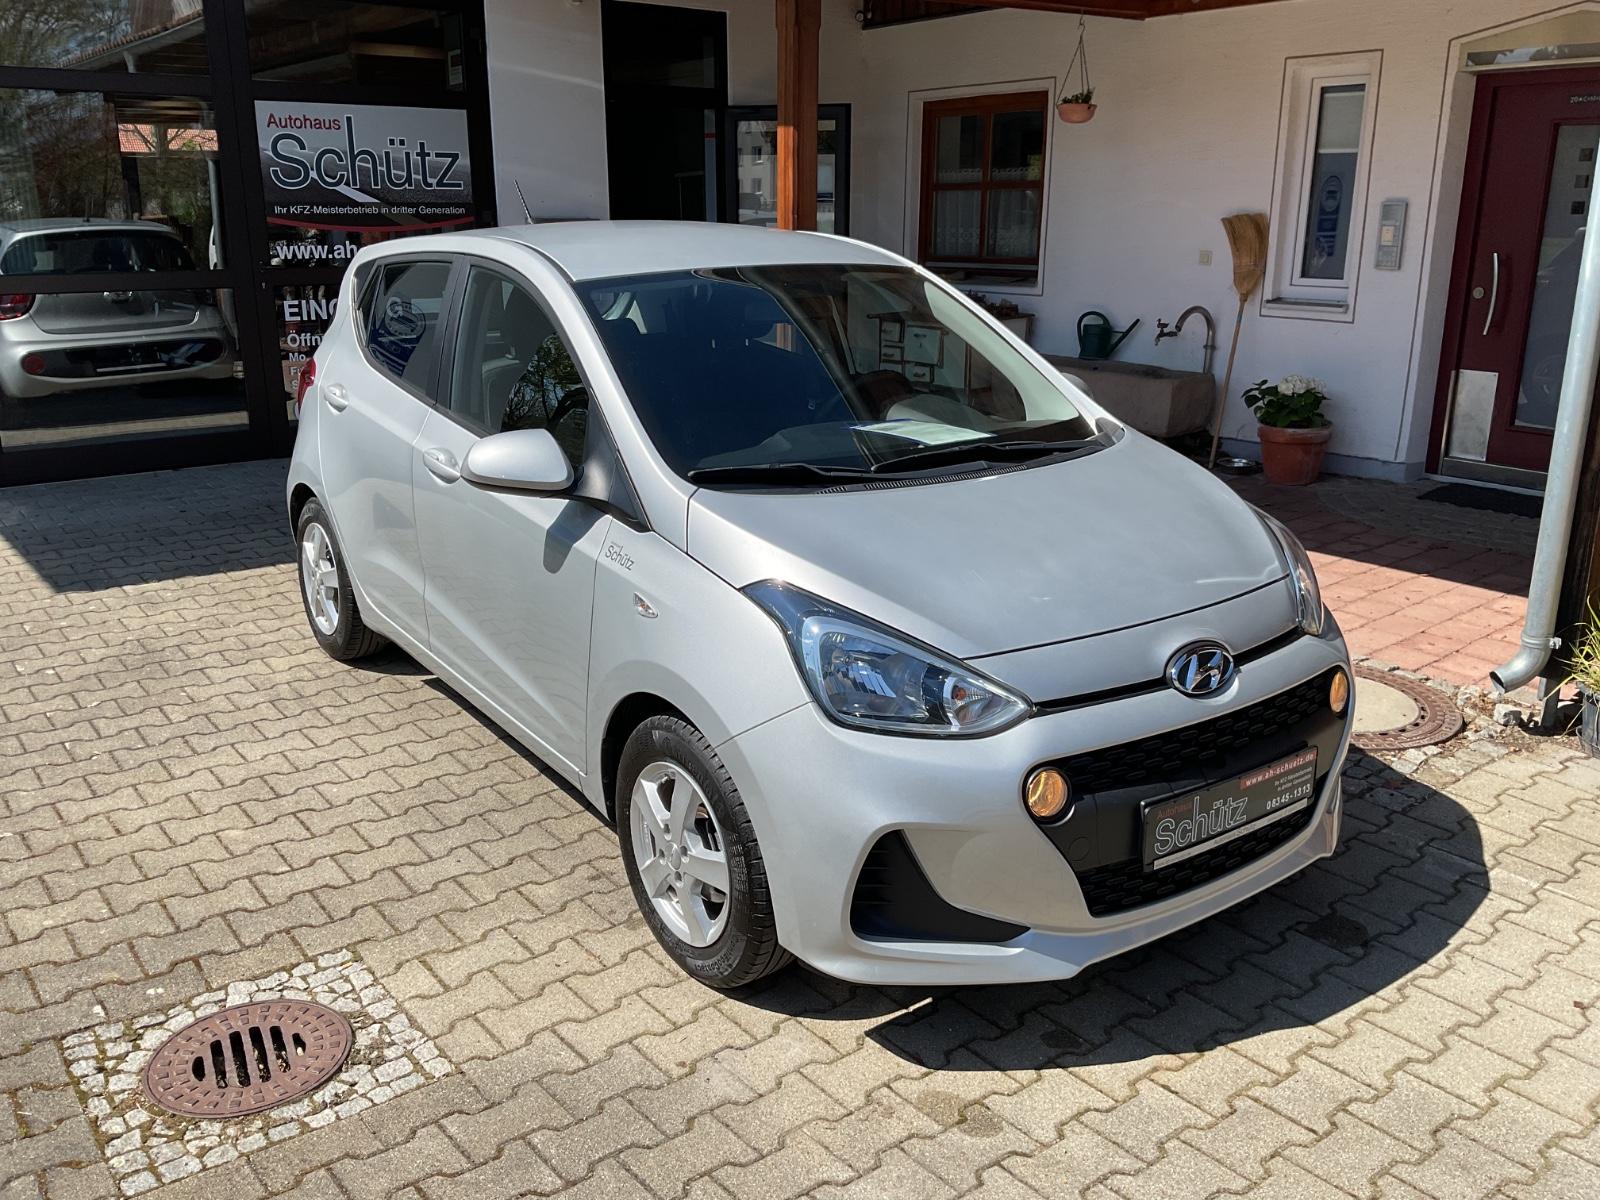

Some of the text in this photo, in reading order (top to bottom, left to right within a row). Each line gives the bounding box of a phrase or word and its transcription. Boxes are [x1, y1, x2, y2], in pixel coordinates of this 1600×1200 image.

[267, 112, 341, 130] Autohaus
[270, 115, 464, 190] Schütz
[274, 205, 466, 215] Ihr KFZ-Meisterbetrieb in dritter Generation
[287, 330, 323, 347] Öffn
[605, 545, 635, 571] Schütz
[1266, 783, 1311, 810] 08345-1313
[1154, 796, 1248, 855] Schütz
